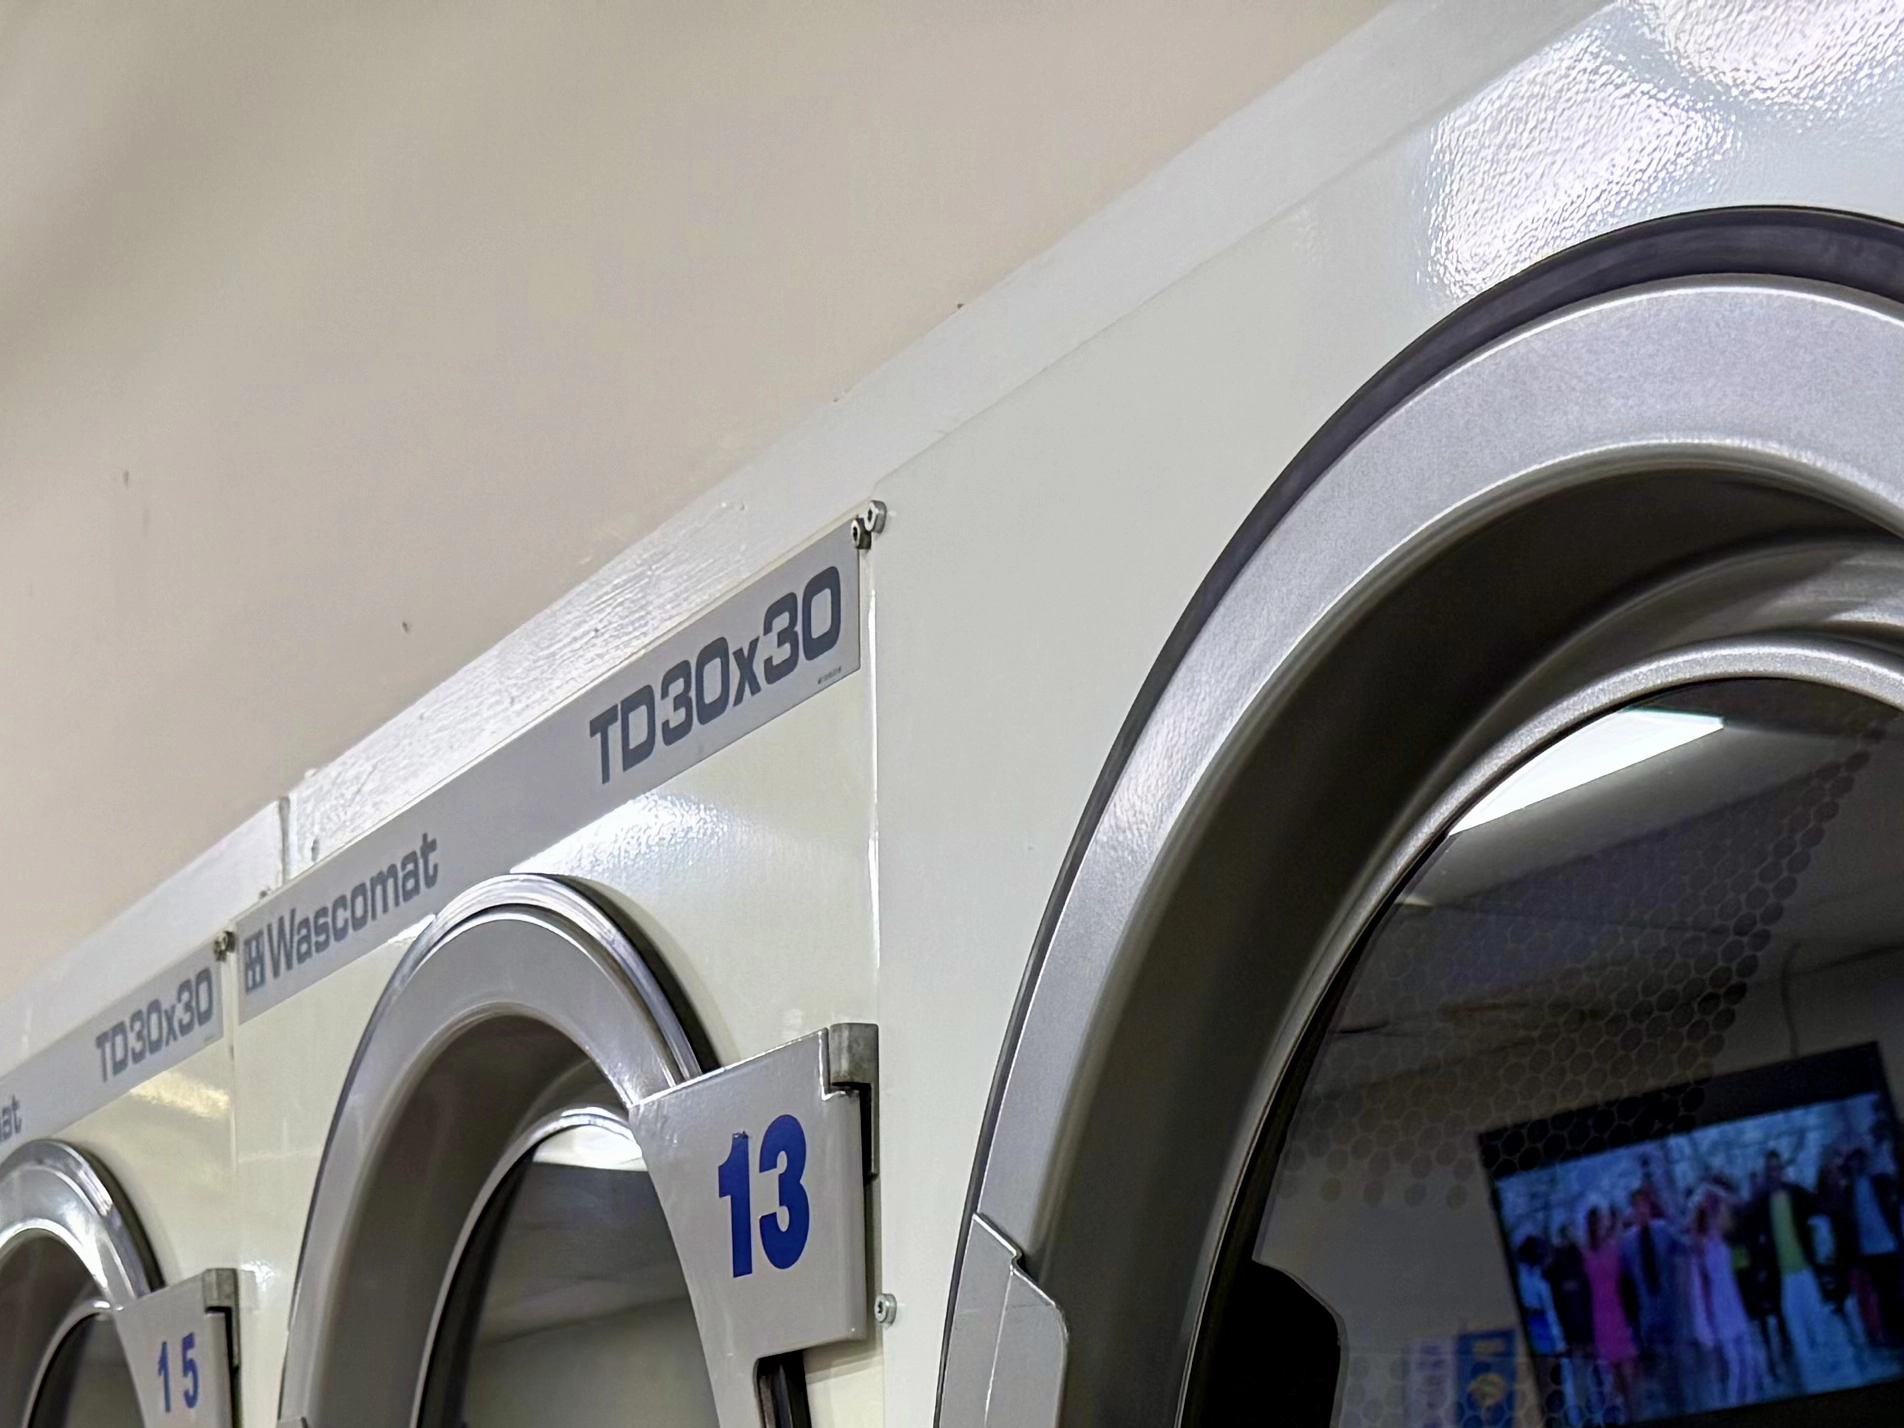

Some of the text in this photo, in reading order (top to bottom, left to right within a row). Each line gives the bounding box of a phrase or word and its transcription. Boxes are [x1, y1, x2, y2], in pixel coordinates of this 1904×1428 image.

[267, 565, 842, 980] Wascomat TD30x30
[95, 967, 214, 1083] TD30x30
[717, 1113, 811, 1279] 13
[157, 1331, 200, 1414] 15
